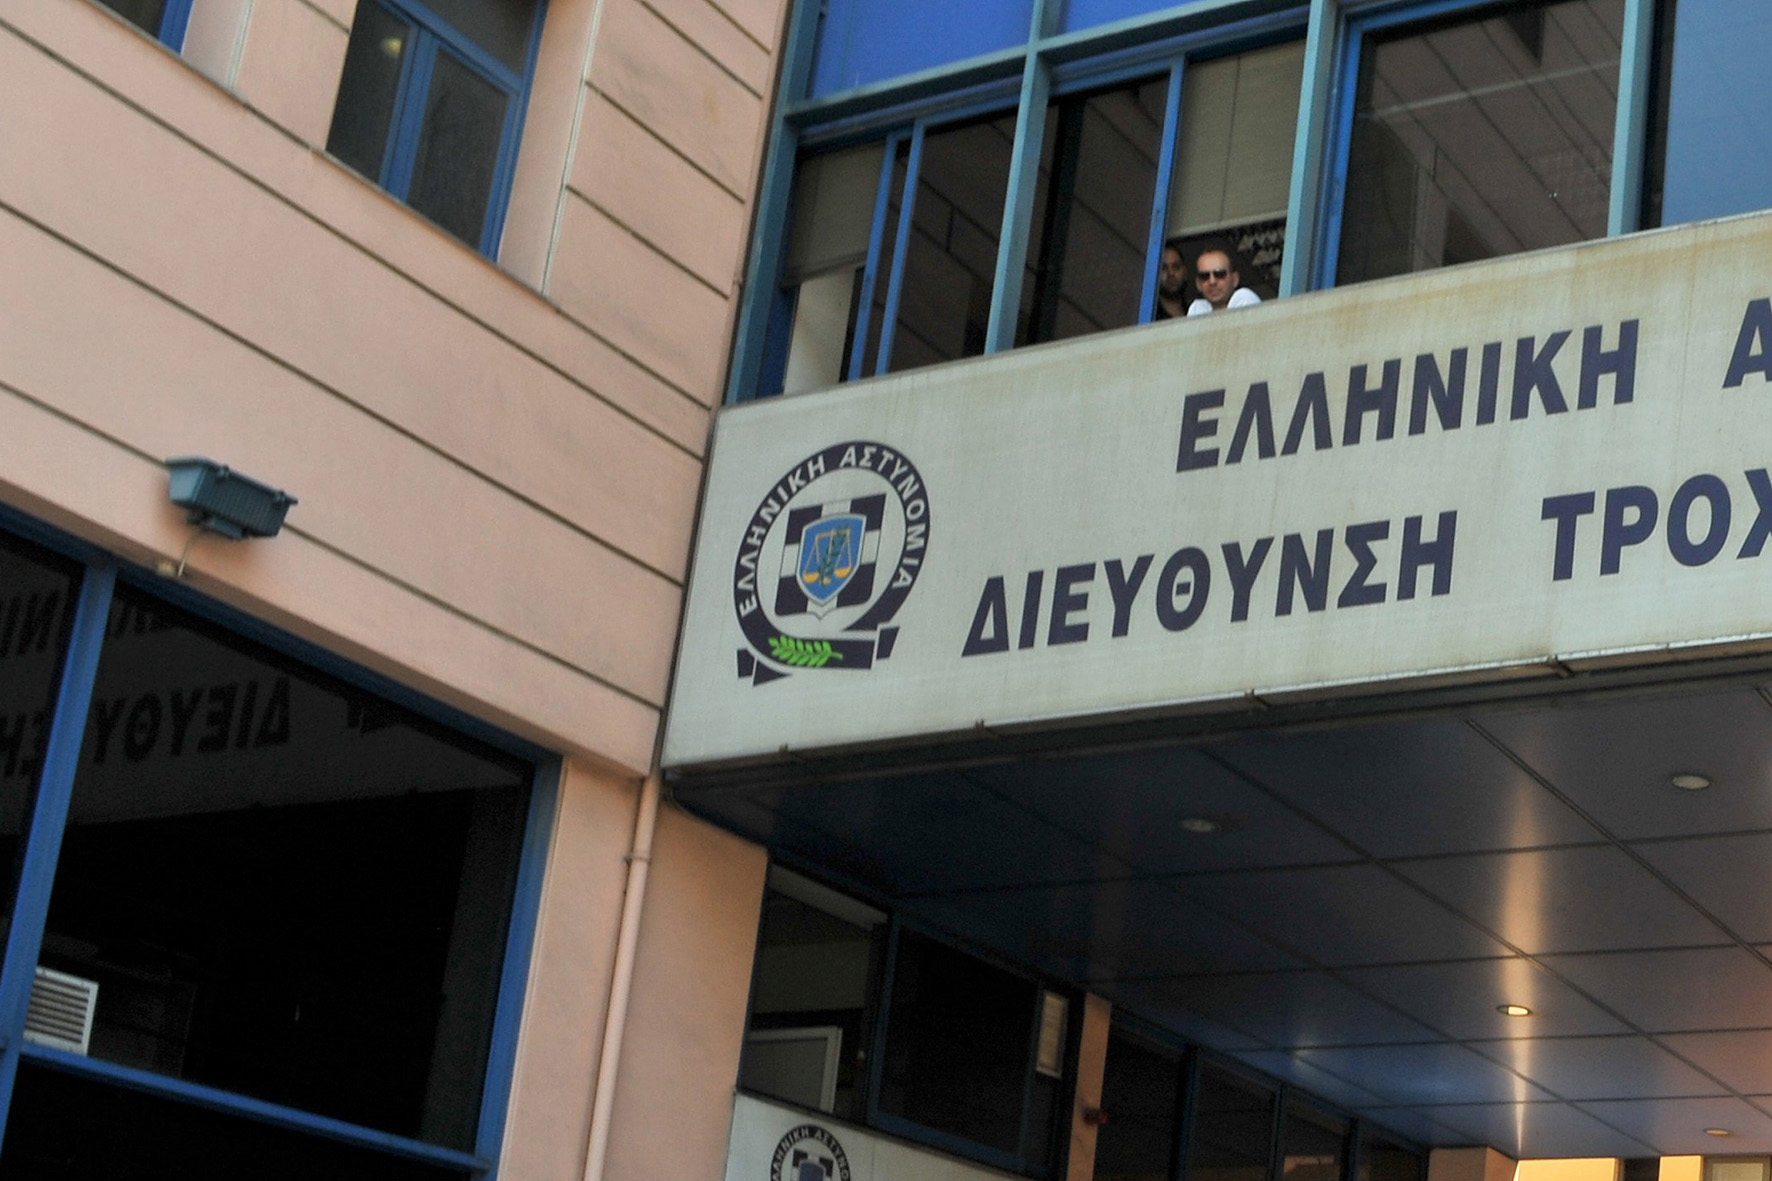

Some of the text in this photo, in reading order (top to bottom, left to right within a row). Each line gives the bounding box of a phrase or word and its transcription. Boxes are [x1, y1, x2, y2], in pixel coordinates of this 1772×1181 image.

[1176, 319, 1640, 473] ΕΛΛΗΝΙΚΗ
[737, 445, 927, 619] ΕΛΛΗΝΙΚΗ ΑΣΤΥΝΟΜΙΑ
[961, 510, 1458, 659] ΔΙΕΥΘΥΝΣΗ
